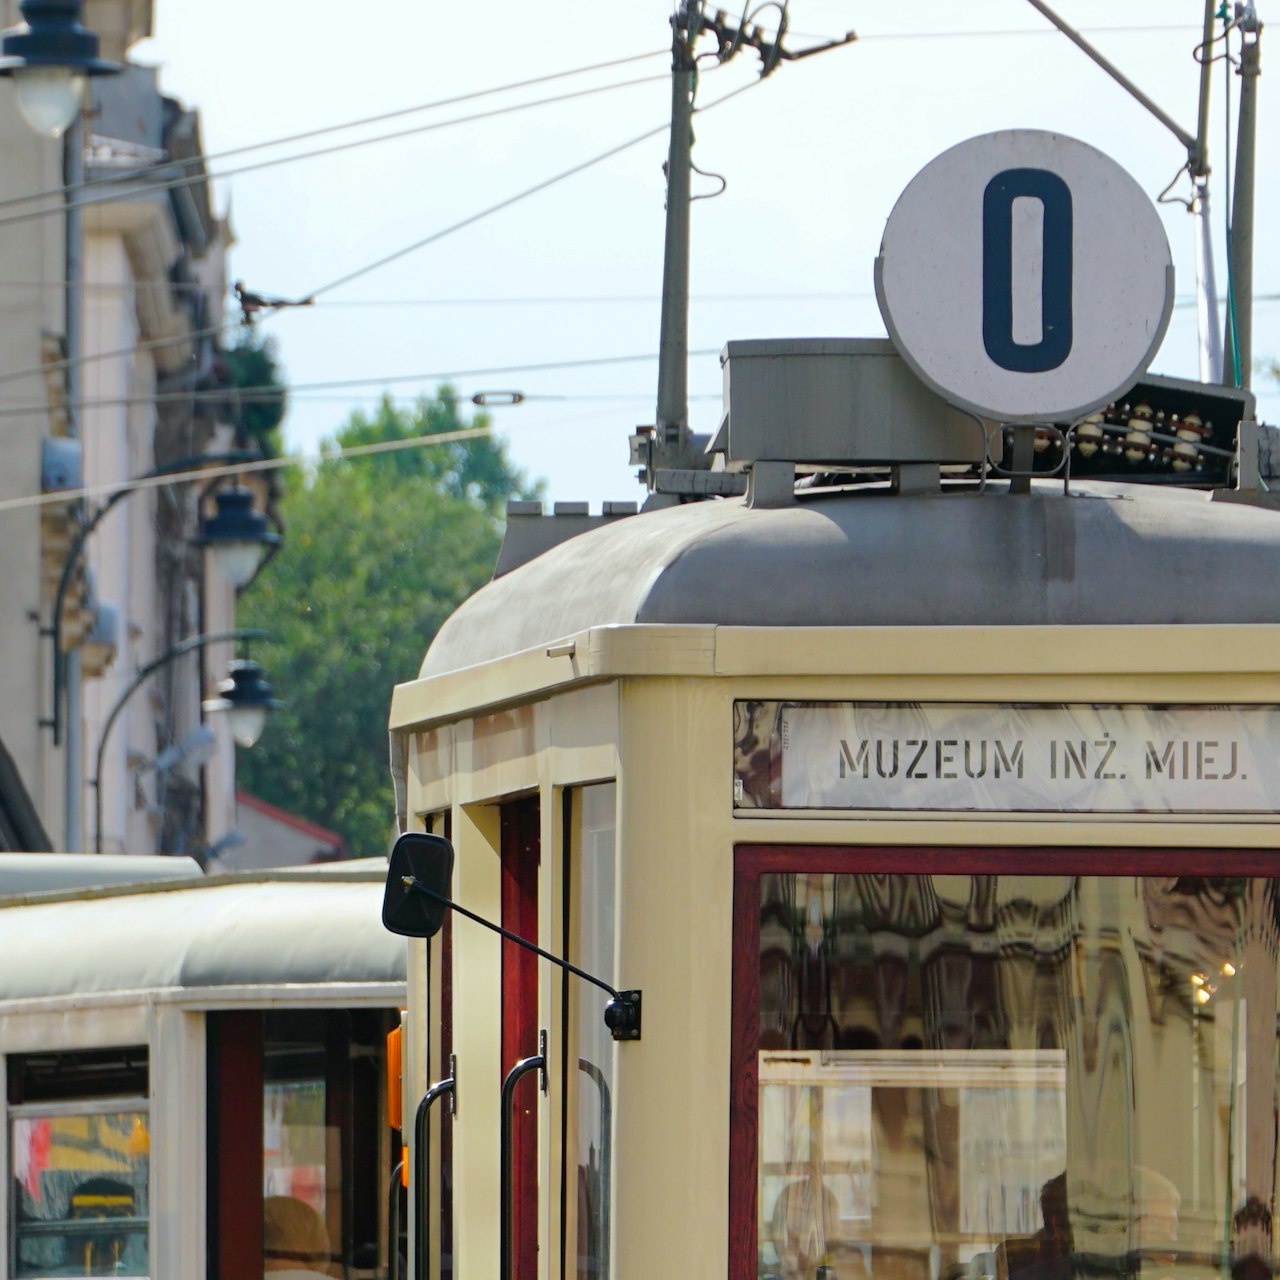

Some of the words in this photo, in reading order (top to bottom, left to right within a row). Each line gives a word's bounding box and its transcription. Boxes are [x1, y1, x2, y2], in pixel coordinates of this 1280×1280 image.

[982, 167, 1073, 374] 0
[839, 739, 1024, 779] MUZEUM
[1050, 732, 1126, 780] INŻ.
[1145, 740, 1247, 780] MIEJ.
